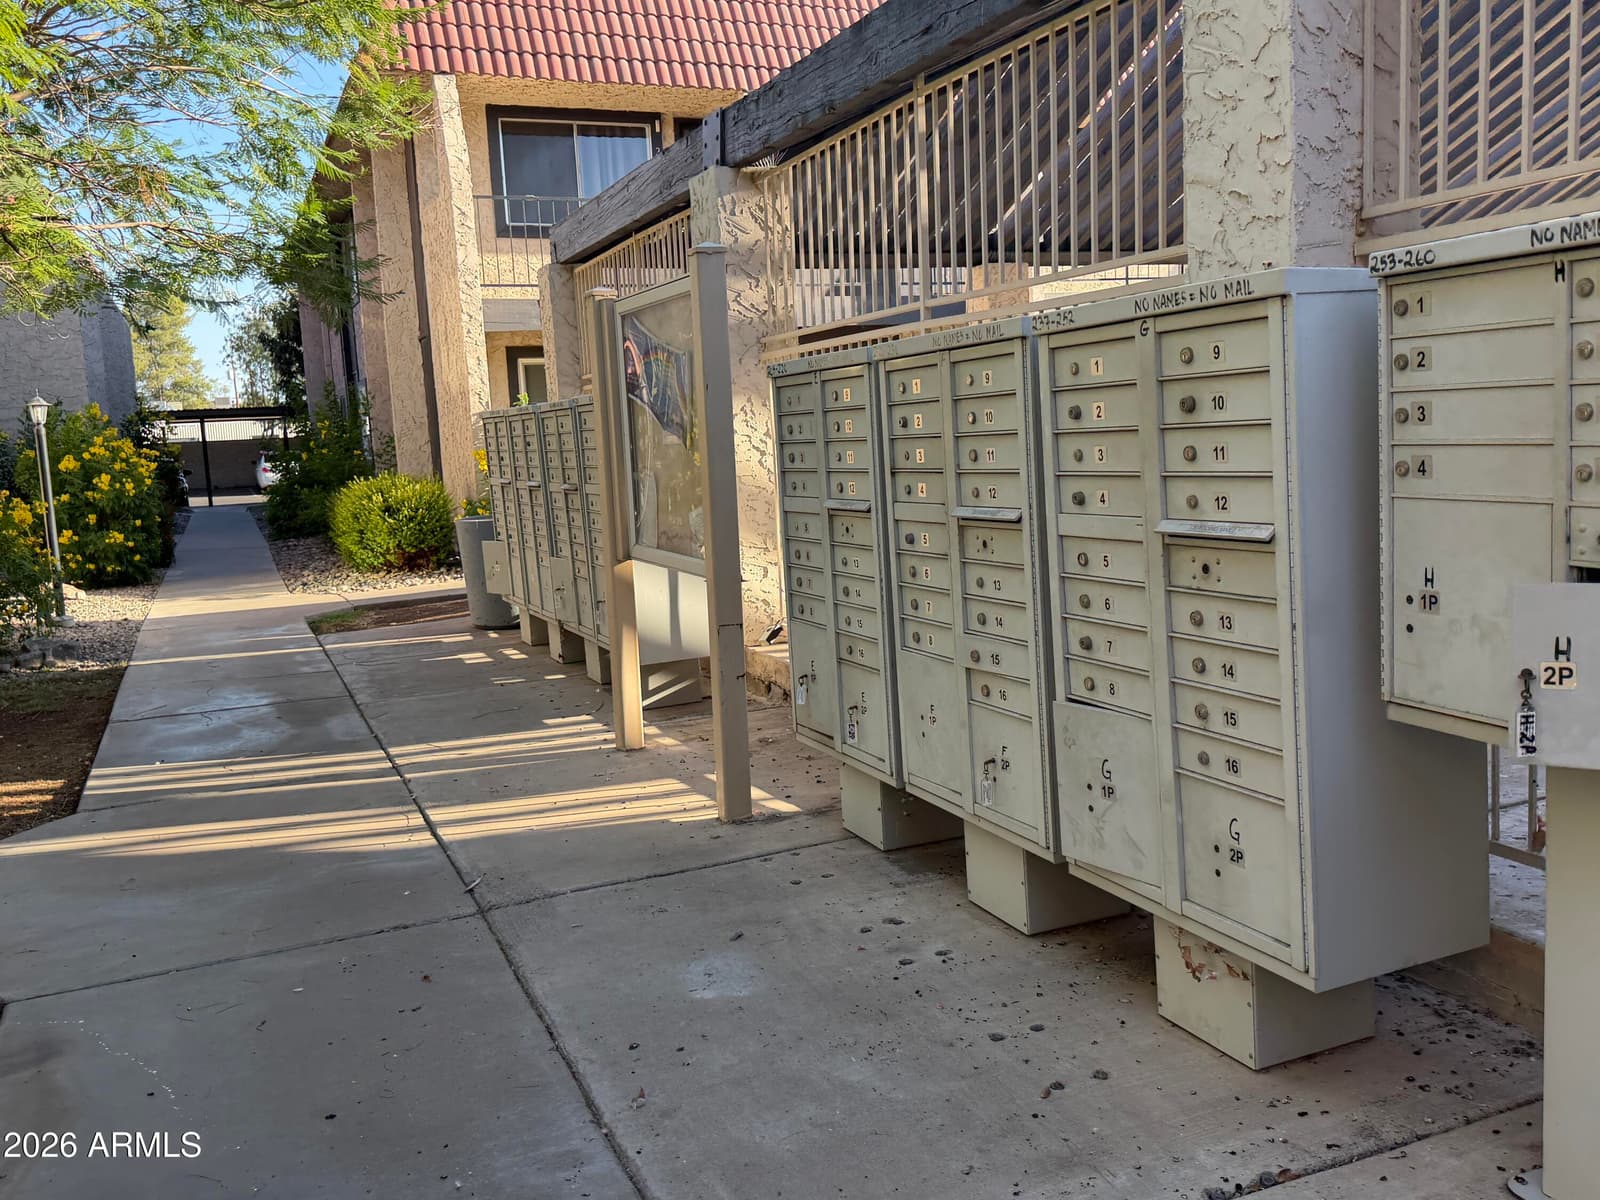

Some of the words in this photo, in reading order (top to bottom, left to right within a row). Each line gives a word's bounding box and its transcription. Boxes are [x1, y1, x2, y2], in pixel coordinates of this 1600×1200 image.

[1530, 227, 1554, 248] NO
[1370, 249, 1436, 274] 253-260
[1555, 260, 1566, 284] H
[1134, 299, 1150, 315] NO
[1200, 286, 1217, 304] NO
[1225, 280, 1256, 300] MAIL
[1416, 297, 1423, 313] 1
[1032, 310, 1075, 331] 237-252
[1139, 320, 1150, 337] G
[1212, 345, 1220, 360] 9
[1094, 360, 1099, 373] 1
[1416, 351, 1426, 369] 2
[985, 372, 990, 384] 9
[1211, 396, 1225, 411] 10
[985, 411, 993, 424] 10
[1096, 406, 1103, 419] 2
[1416, 405, 1426, 422] 3
[916, 416, 921, 427] 2
[918, 450, 923, 462] 3
[987, 450, 995, 462] 11
[1098, 449, 1104, 462] 3
[1213, 447, 1226, 461] 11
[1416, 459, 1427, 476] 4
[920, 484, 925, 495] 4
[988, 487, 997, 499] 12
[1100, 493, 1106, 506] 4
[1214, 497, 1228, 511] 12
[923, 534, 928, 545] 5
[1103, 555, 1109, 568] 5
[1424, 567, 1434, 588] H
[993, 580, 1002, 591] 13
[926, 602, 931, 613] 7
[1105, 598, 1111, 611] 6
[1420, 594, 1439, 611] 1P
[995, 617, 1003, 628] 14
[1220, 616, 1232, 630] 13
[1107, 640, 1113, 653] 7
[1554, 636, 1571, 661] H
[990, 653, 1000, 666] 15
[1221, 664, 1234, 679] 14
[1543, 666, 1574, 685] 2P
[999, 689, 1008, 701] 16
[1110, 683, 1115, 696] 8
[1223, 712, 1237, 727] 15
[1001, 746, 1008, 756] F
[1001, 759, 1010, 771] 2P
[1101, 759, 1112, 782] G
[1225, 758, 1238, 774] 16
[1101, 786, 1115, 799] 1P
[1229, 818, 1240, 845] G
[1229, 849, 1243, 864] 2P
